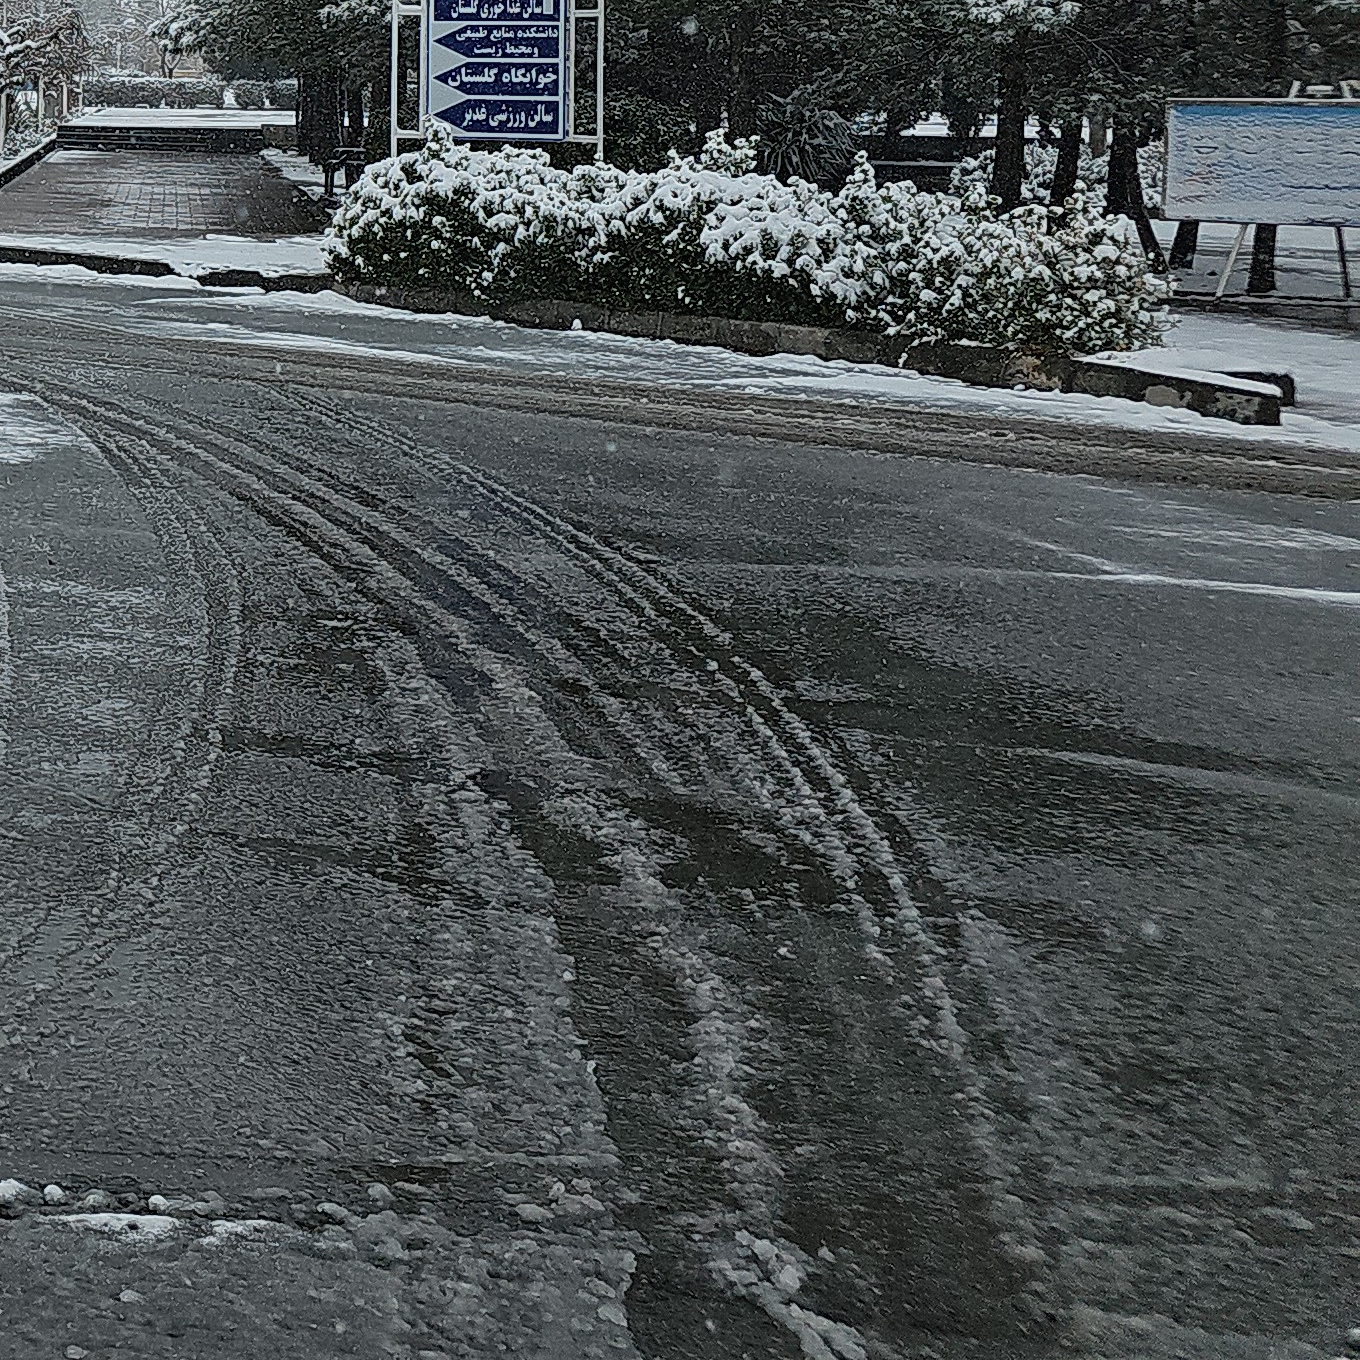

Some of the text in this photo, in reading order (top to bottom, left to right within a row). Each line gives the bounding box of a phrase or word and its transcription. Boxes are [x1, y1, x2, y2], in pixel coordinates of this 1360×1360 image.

[455, 26, 559, 42] دانشکده منابع طبیعی
[473, 44, 503, 58] زیست
[447, 66, 558, 89] خوابگاه گلستان
[460, 103, 554, 128] سالن ورزشی غدیر
